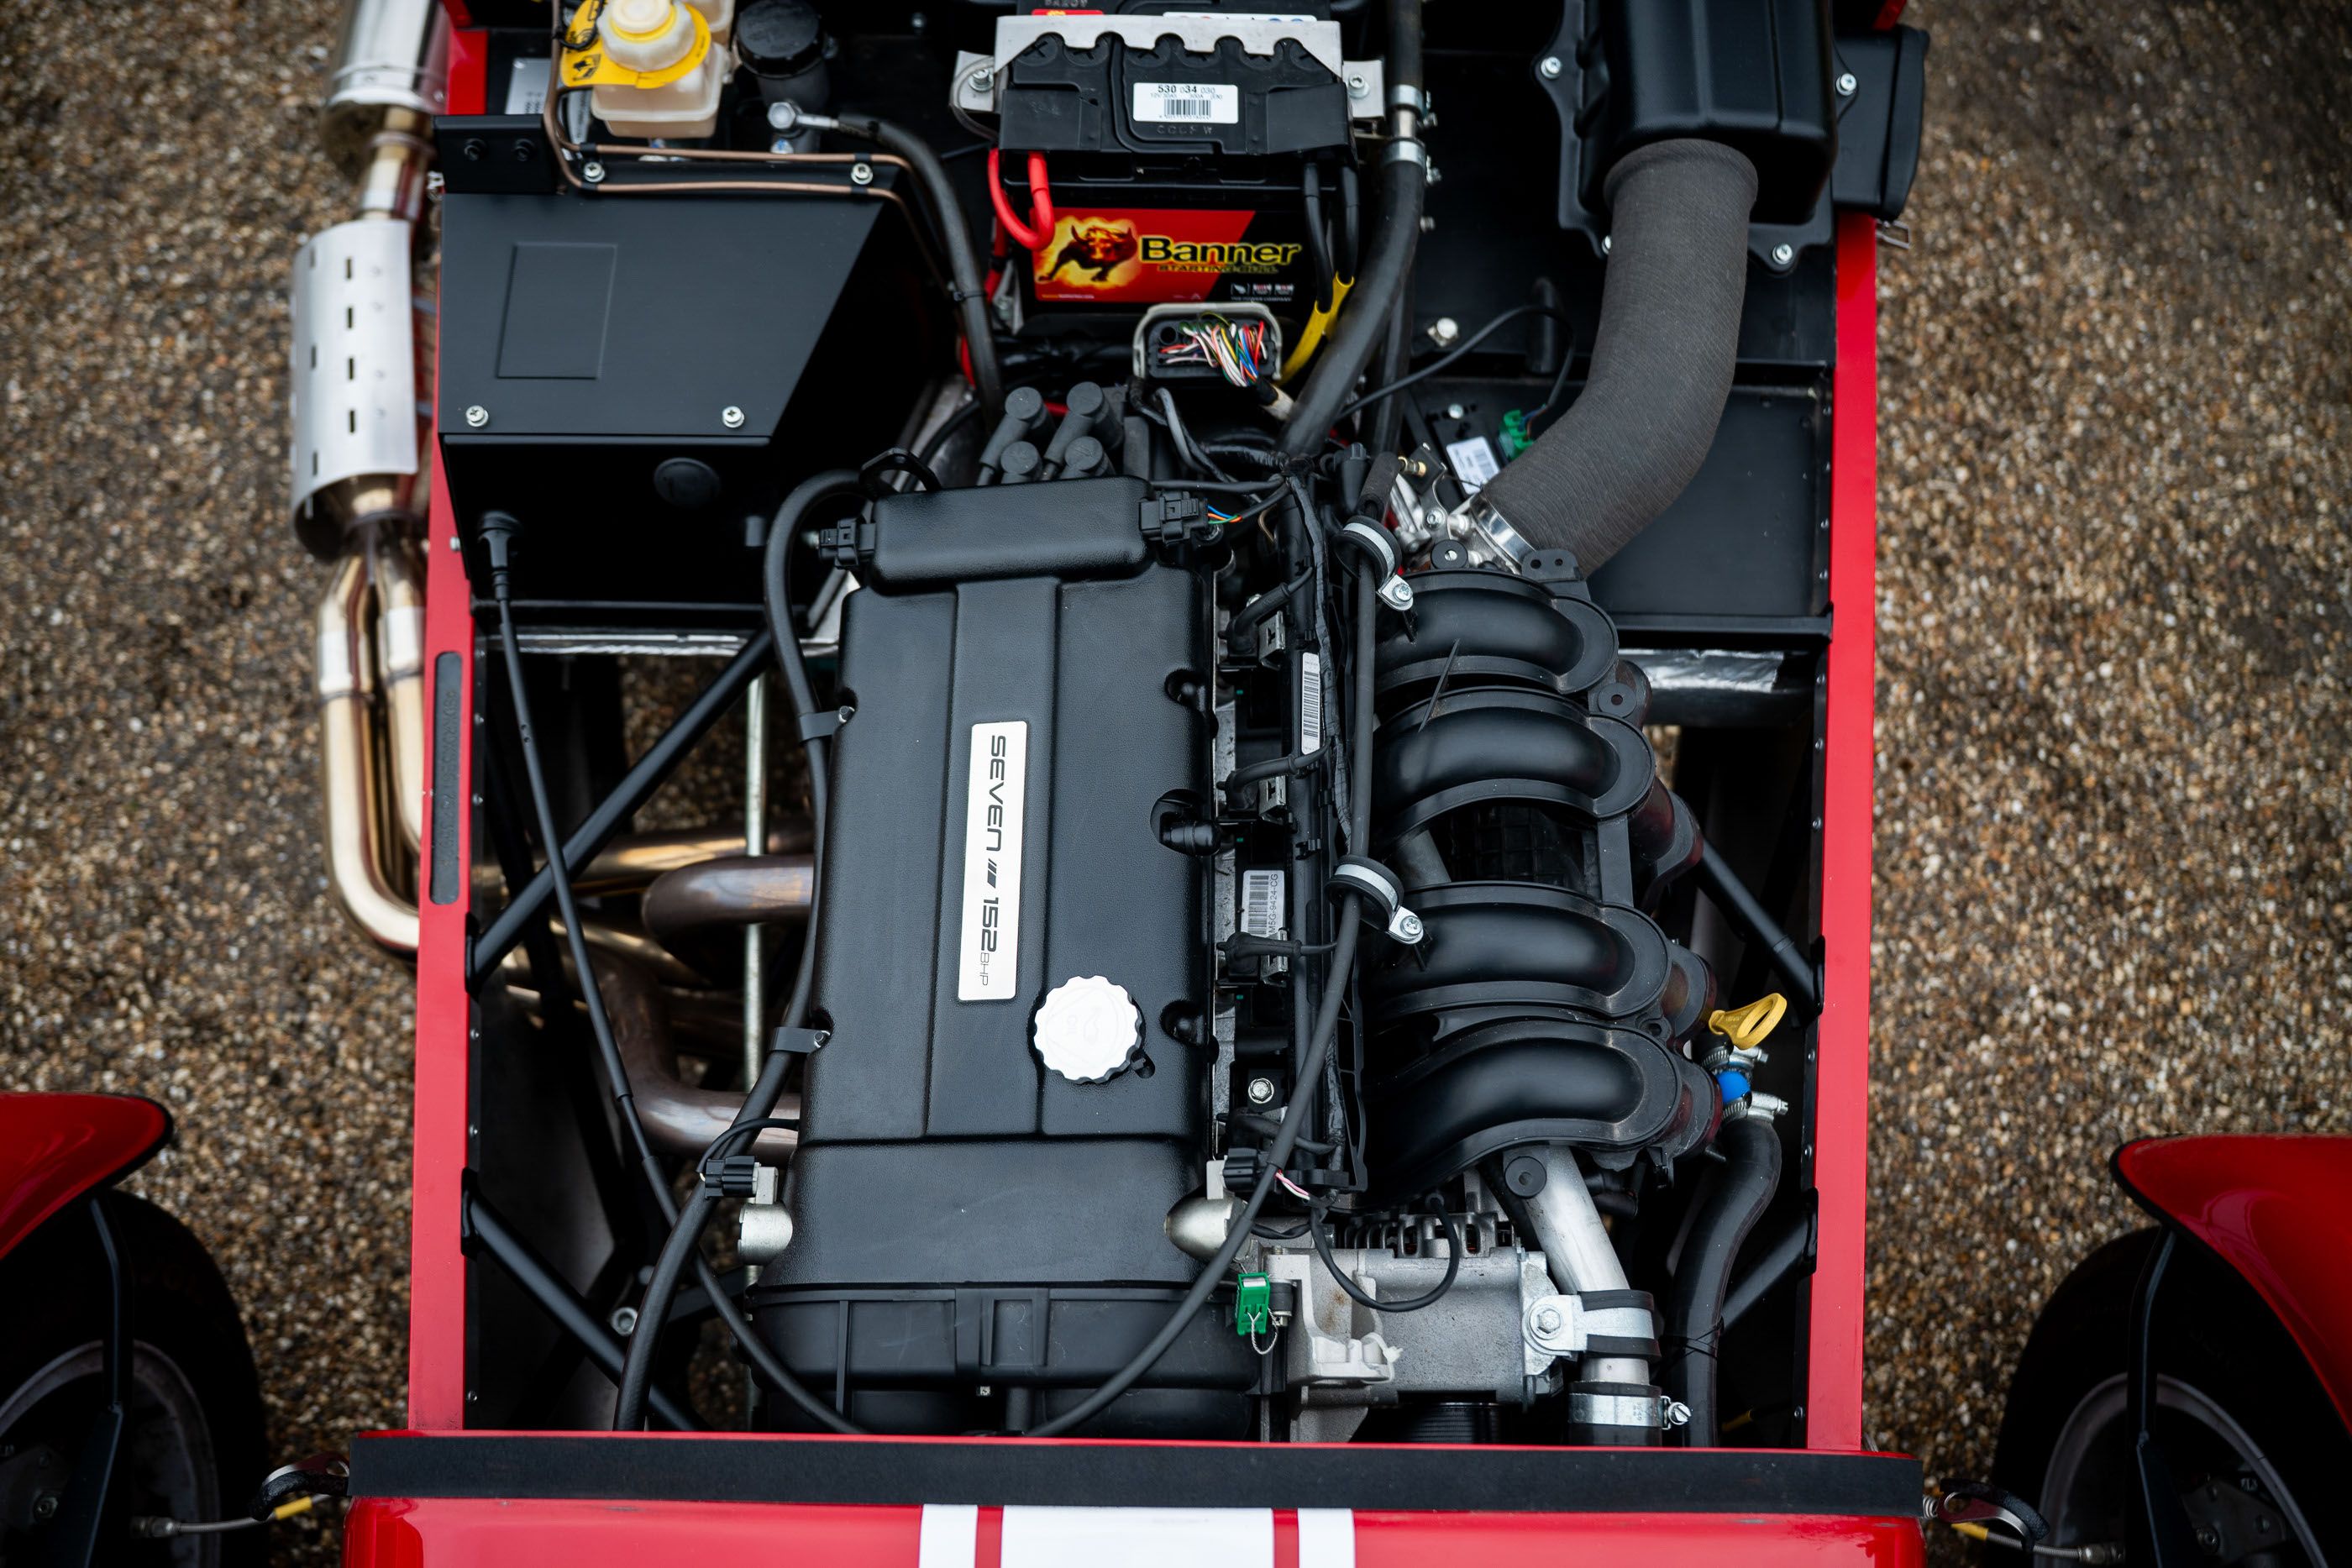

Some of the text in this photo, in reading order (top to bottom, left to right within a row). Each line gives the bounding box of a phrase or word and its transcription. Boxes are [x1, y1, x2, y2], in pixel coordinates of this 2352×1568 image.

[1158, 85, 1177, 93] 530
[1139, 234, 1302, 266] Banner
[985, 735, 1006, 852] SEVEN
